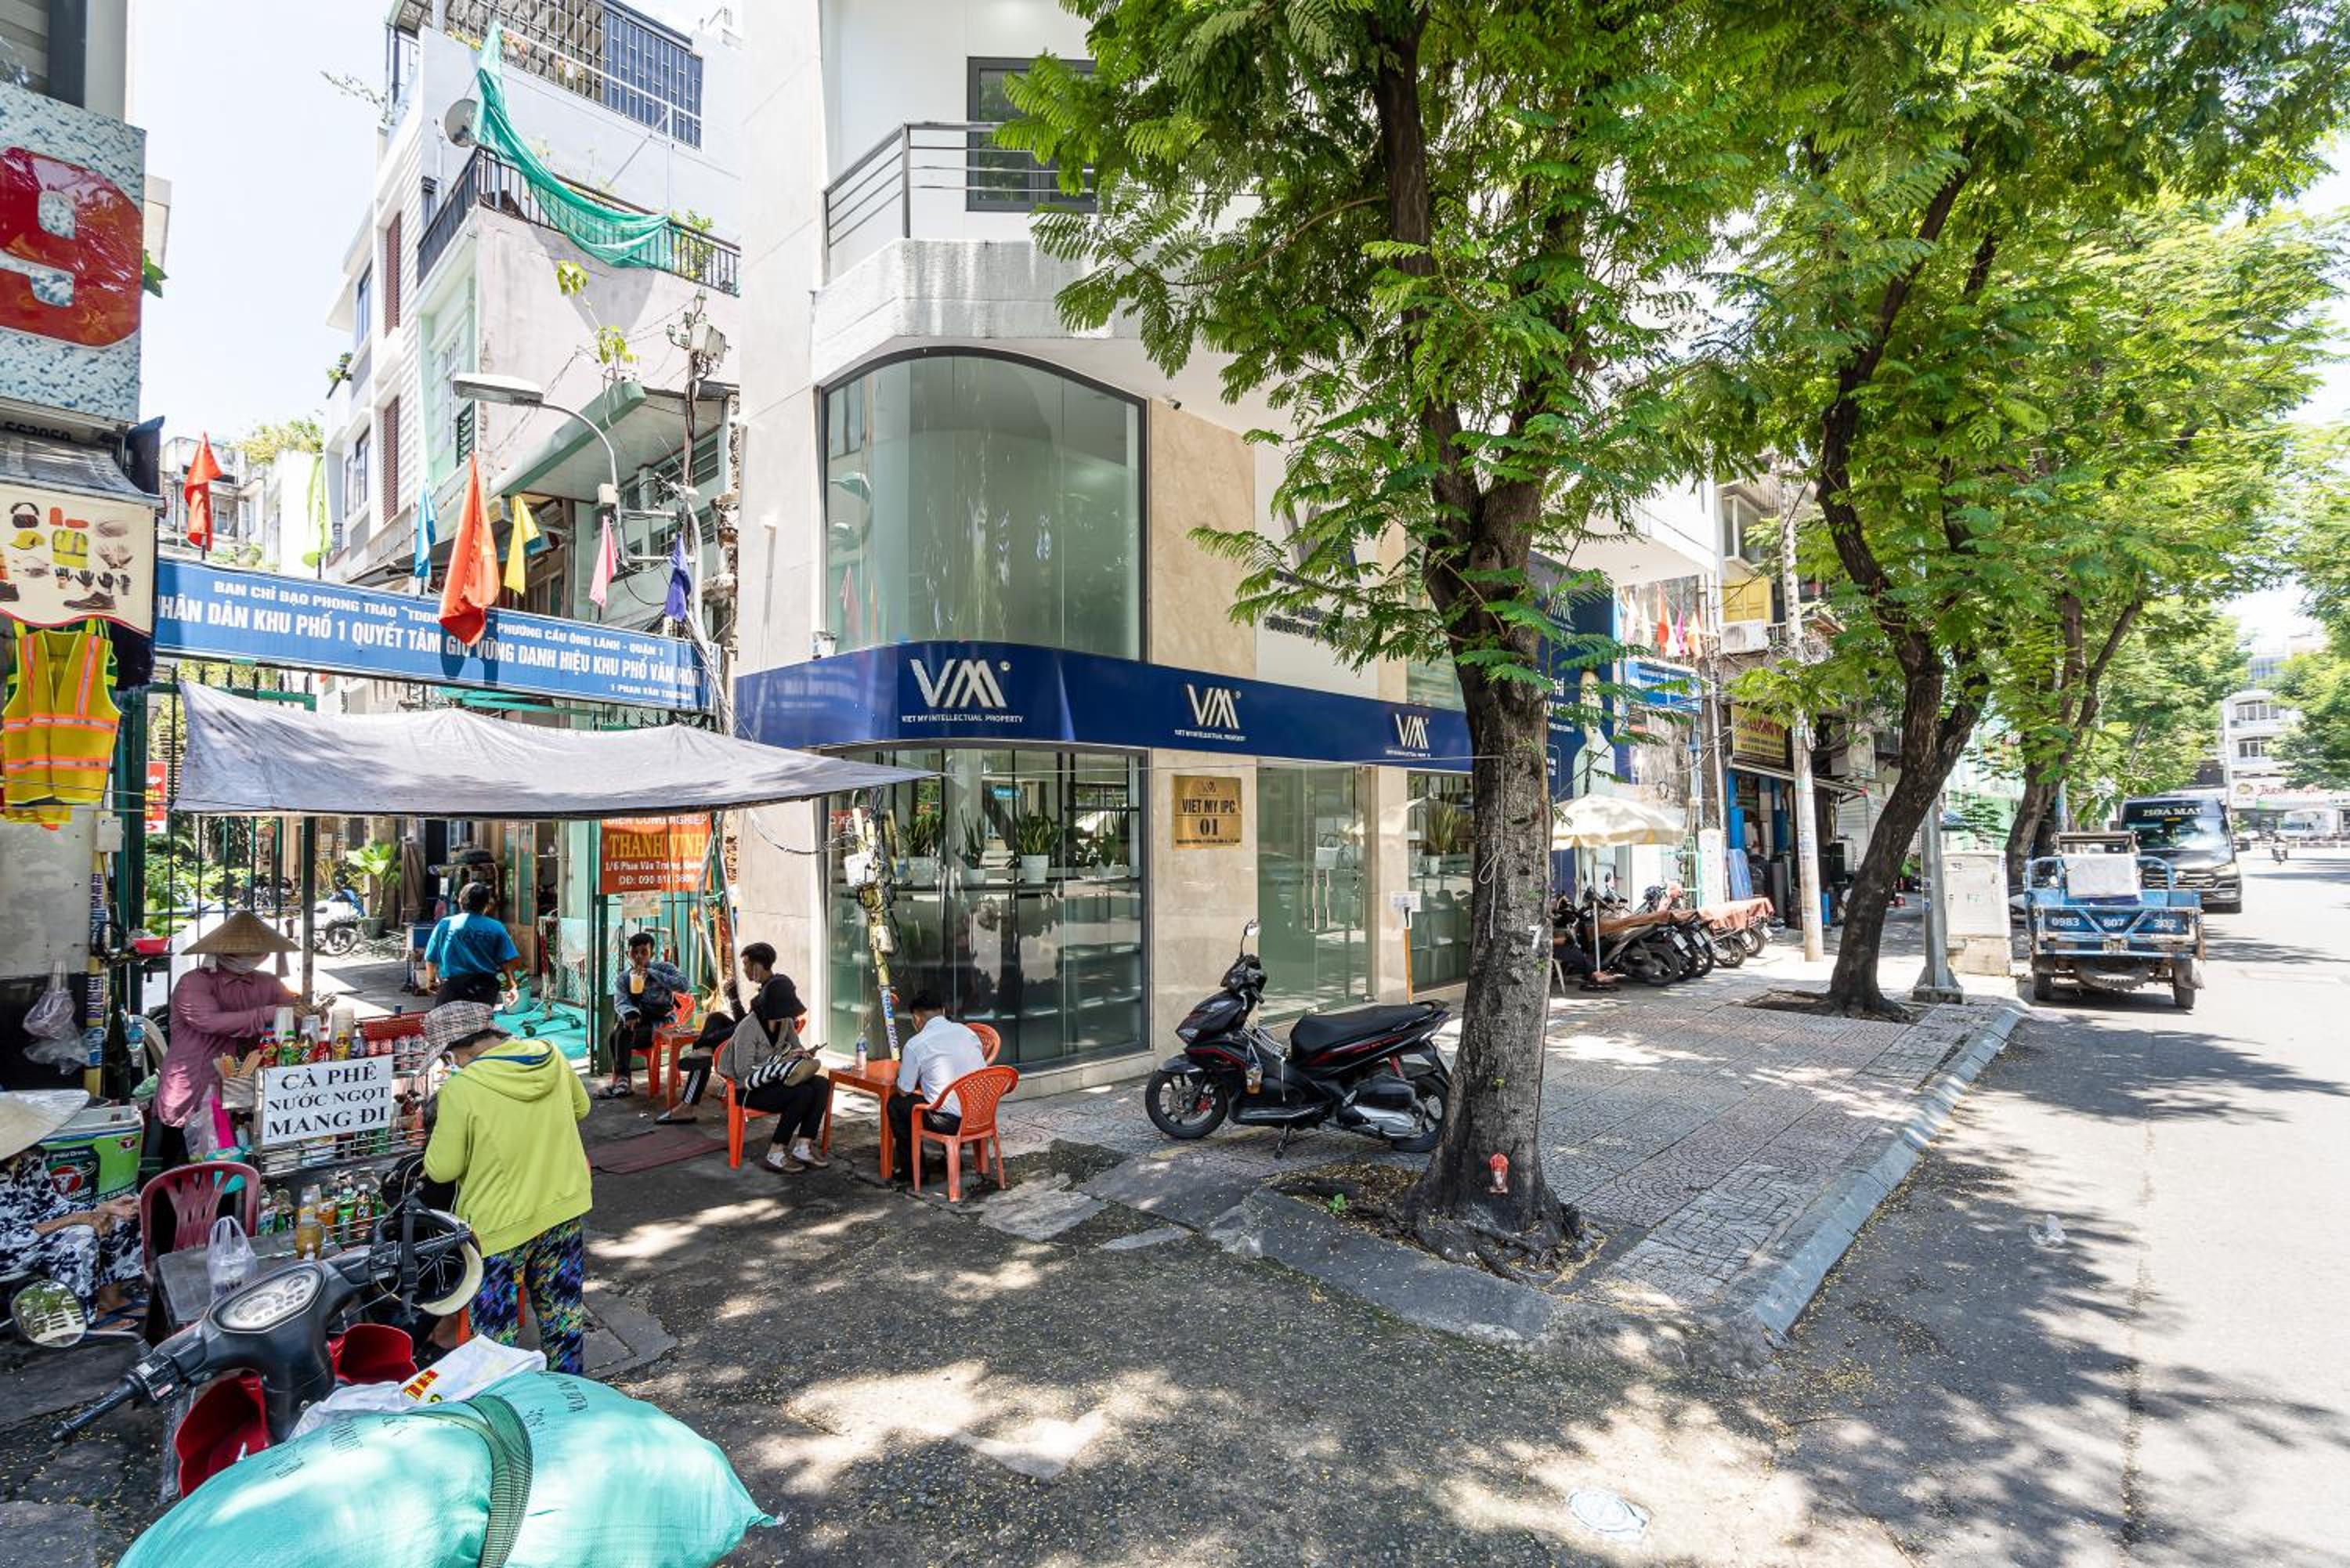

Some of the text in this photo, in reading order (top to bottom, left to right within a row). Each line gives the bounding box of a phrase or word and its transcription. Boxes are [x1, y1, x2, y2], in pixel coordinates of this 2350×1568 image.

[214, 580, 247, 597] BAN
[313, 594, 360, 613] PHONG
[658, 647, 664, 657] 1
[207, 599, 249, 629] DÂN
[253, 609, 291, 634] KHU
[296, 610, 333, 639] PHỐ
[337, 620, 346, 641] 1
[352, 620, 403, 648] QUYẾT
[408, 623, 442, 653] TÂM
[518, 643, 555, 668] DANH
[559, 649, 590, 676] HIỆU
[593, 654, 619, 677] KHU
[622, 655, 648, 680] PHỐ
[650, 661, 674, 684] VĂN
[917, 714, 928, 723] MY
[929, 714, 983, 722] INTELLECTUAL
[985, 714, 1024, 724] PROPERTY
[1182, 799, 1235, 814] VIET MY IPC
[2051, 917, 2080, 927] 0983
[281, 1061, 378, 1090] CÀ PHÊ
[267, 1086, 389, 1113] NƯỚC NGỌT
[267, 1107, 388, 1137] MANG ĐI
